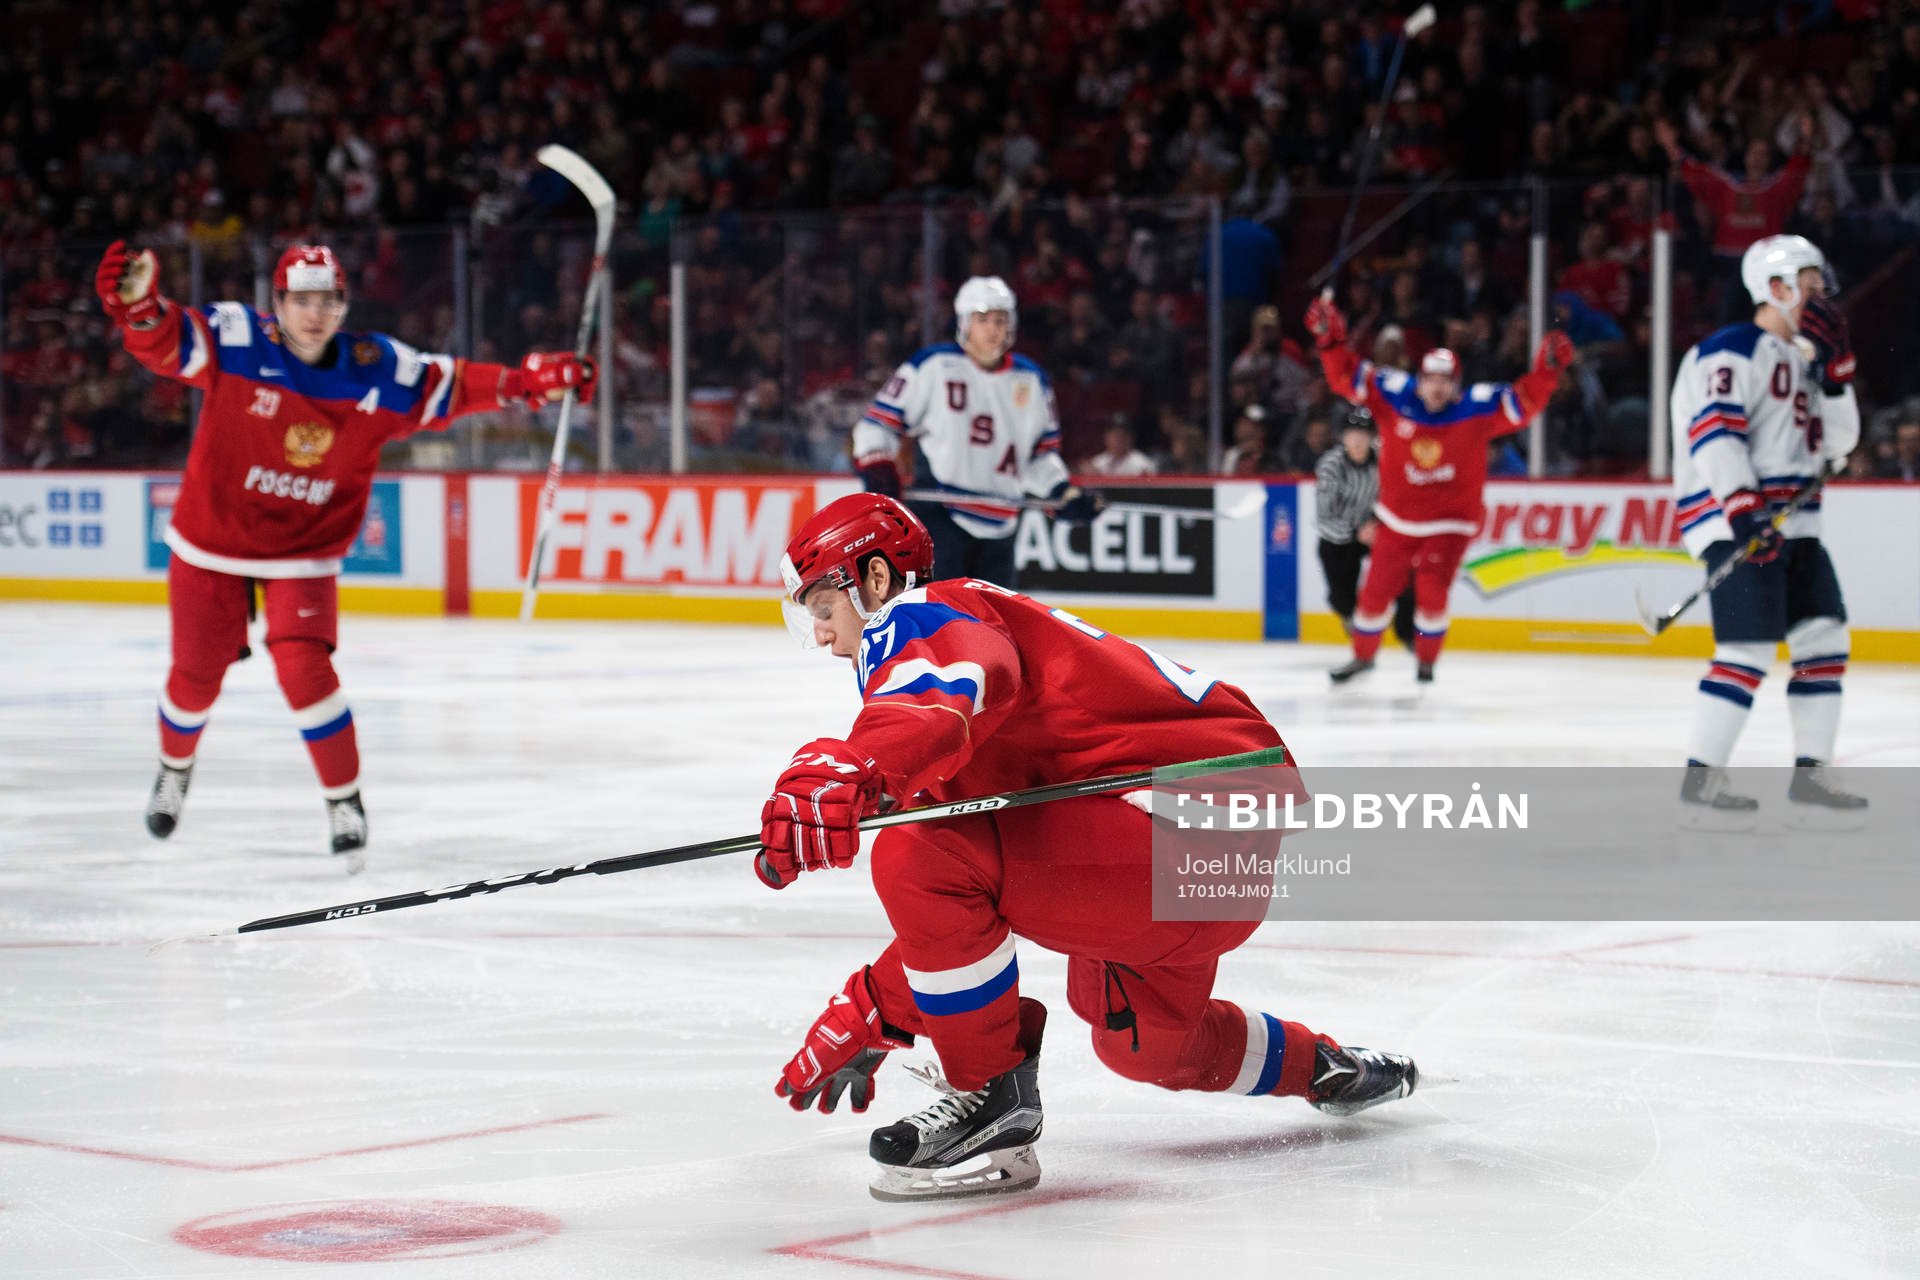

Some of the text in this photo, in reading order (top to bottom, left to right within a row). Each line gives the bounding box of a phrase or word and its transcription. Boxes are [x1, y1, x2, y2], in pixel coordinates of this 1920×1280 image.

[356, 387, 380, 415] A
[0, 504, 40, 548] ec
[538, 486, 802, 583] FRAM
[843, 531, 876, 553] CCM
[1014, 507, 1196, 573] ACELL
[789, 752, 860, 774] CM
[949, 800, 999, 815] CCM
[325, 904, 377, 920] CCM
